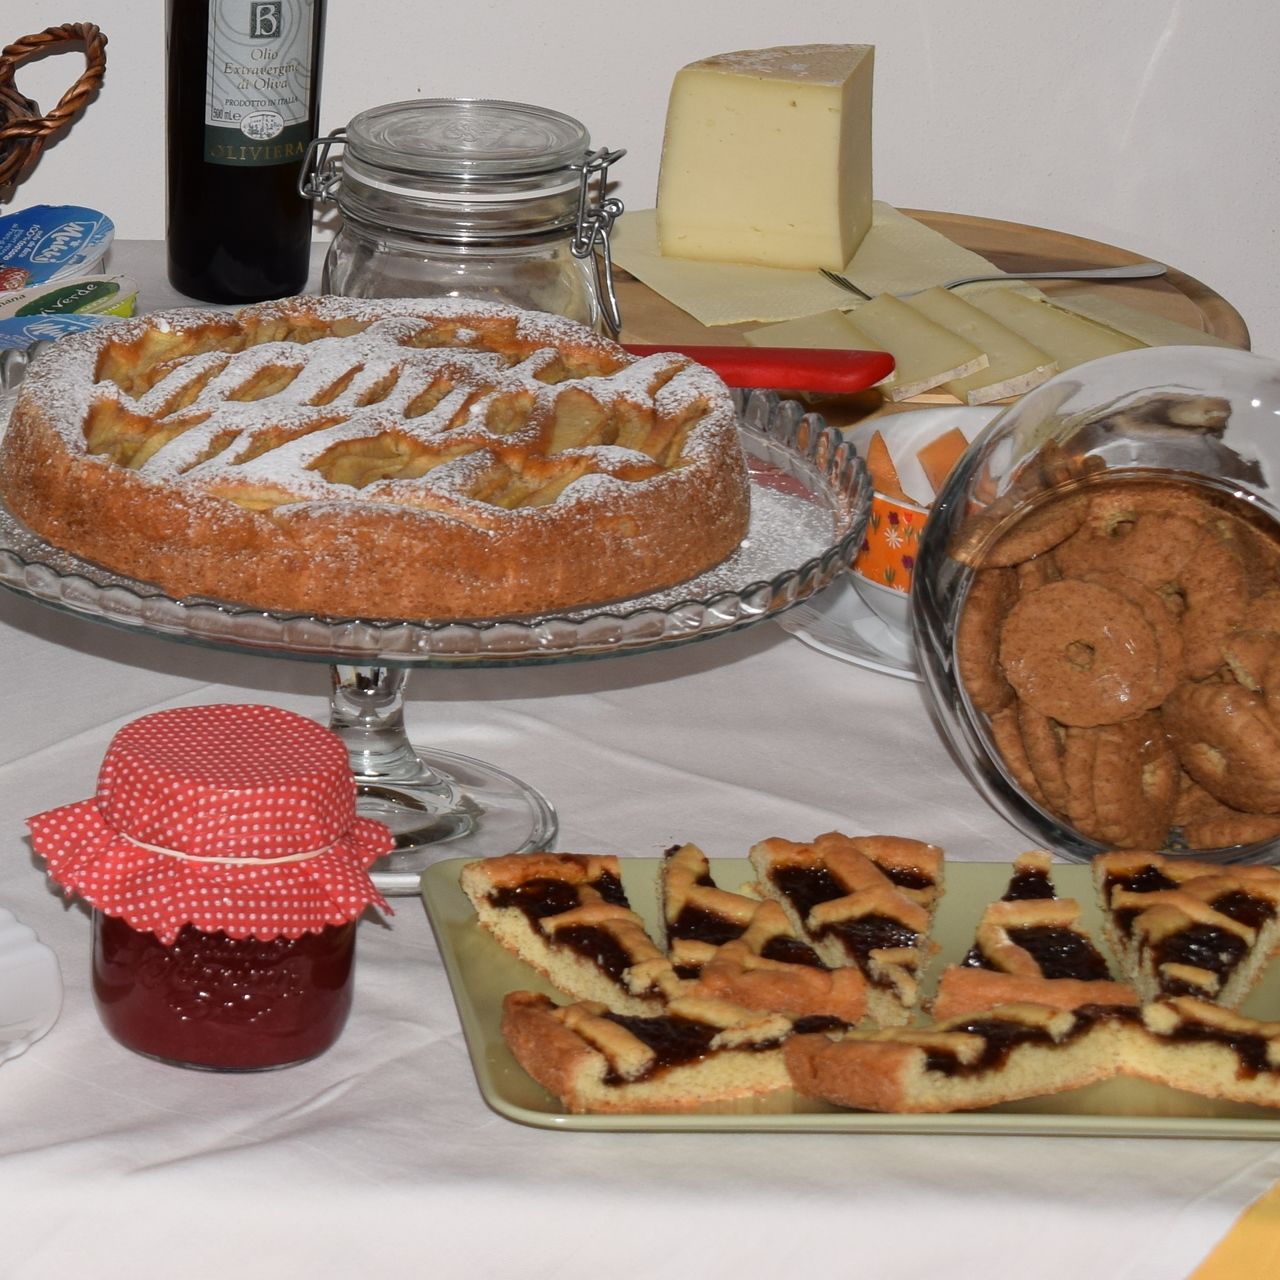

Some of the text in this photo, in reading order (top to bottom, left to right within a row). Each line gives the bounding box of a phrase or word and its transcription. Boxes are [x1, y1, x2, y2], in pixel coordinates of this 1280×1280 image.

[250, 48, 279, 60] Olio
[223, 62, 300, 77] Extravergine
[237, 78, 288, 90] di Oliva
[225, 98, 267, 107] PRODOTTO
[277, 96, 298, 106] ITALIA
[209, 143, 304, 161] OLIVIERA
[52, 282, 99, 308] verde
